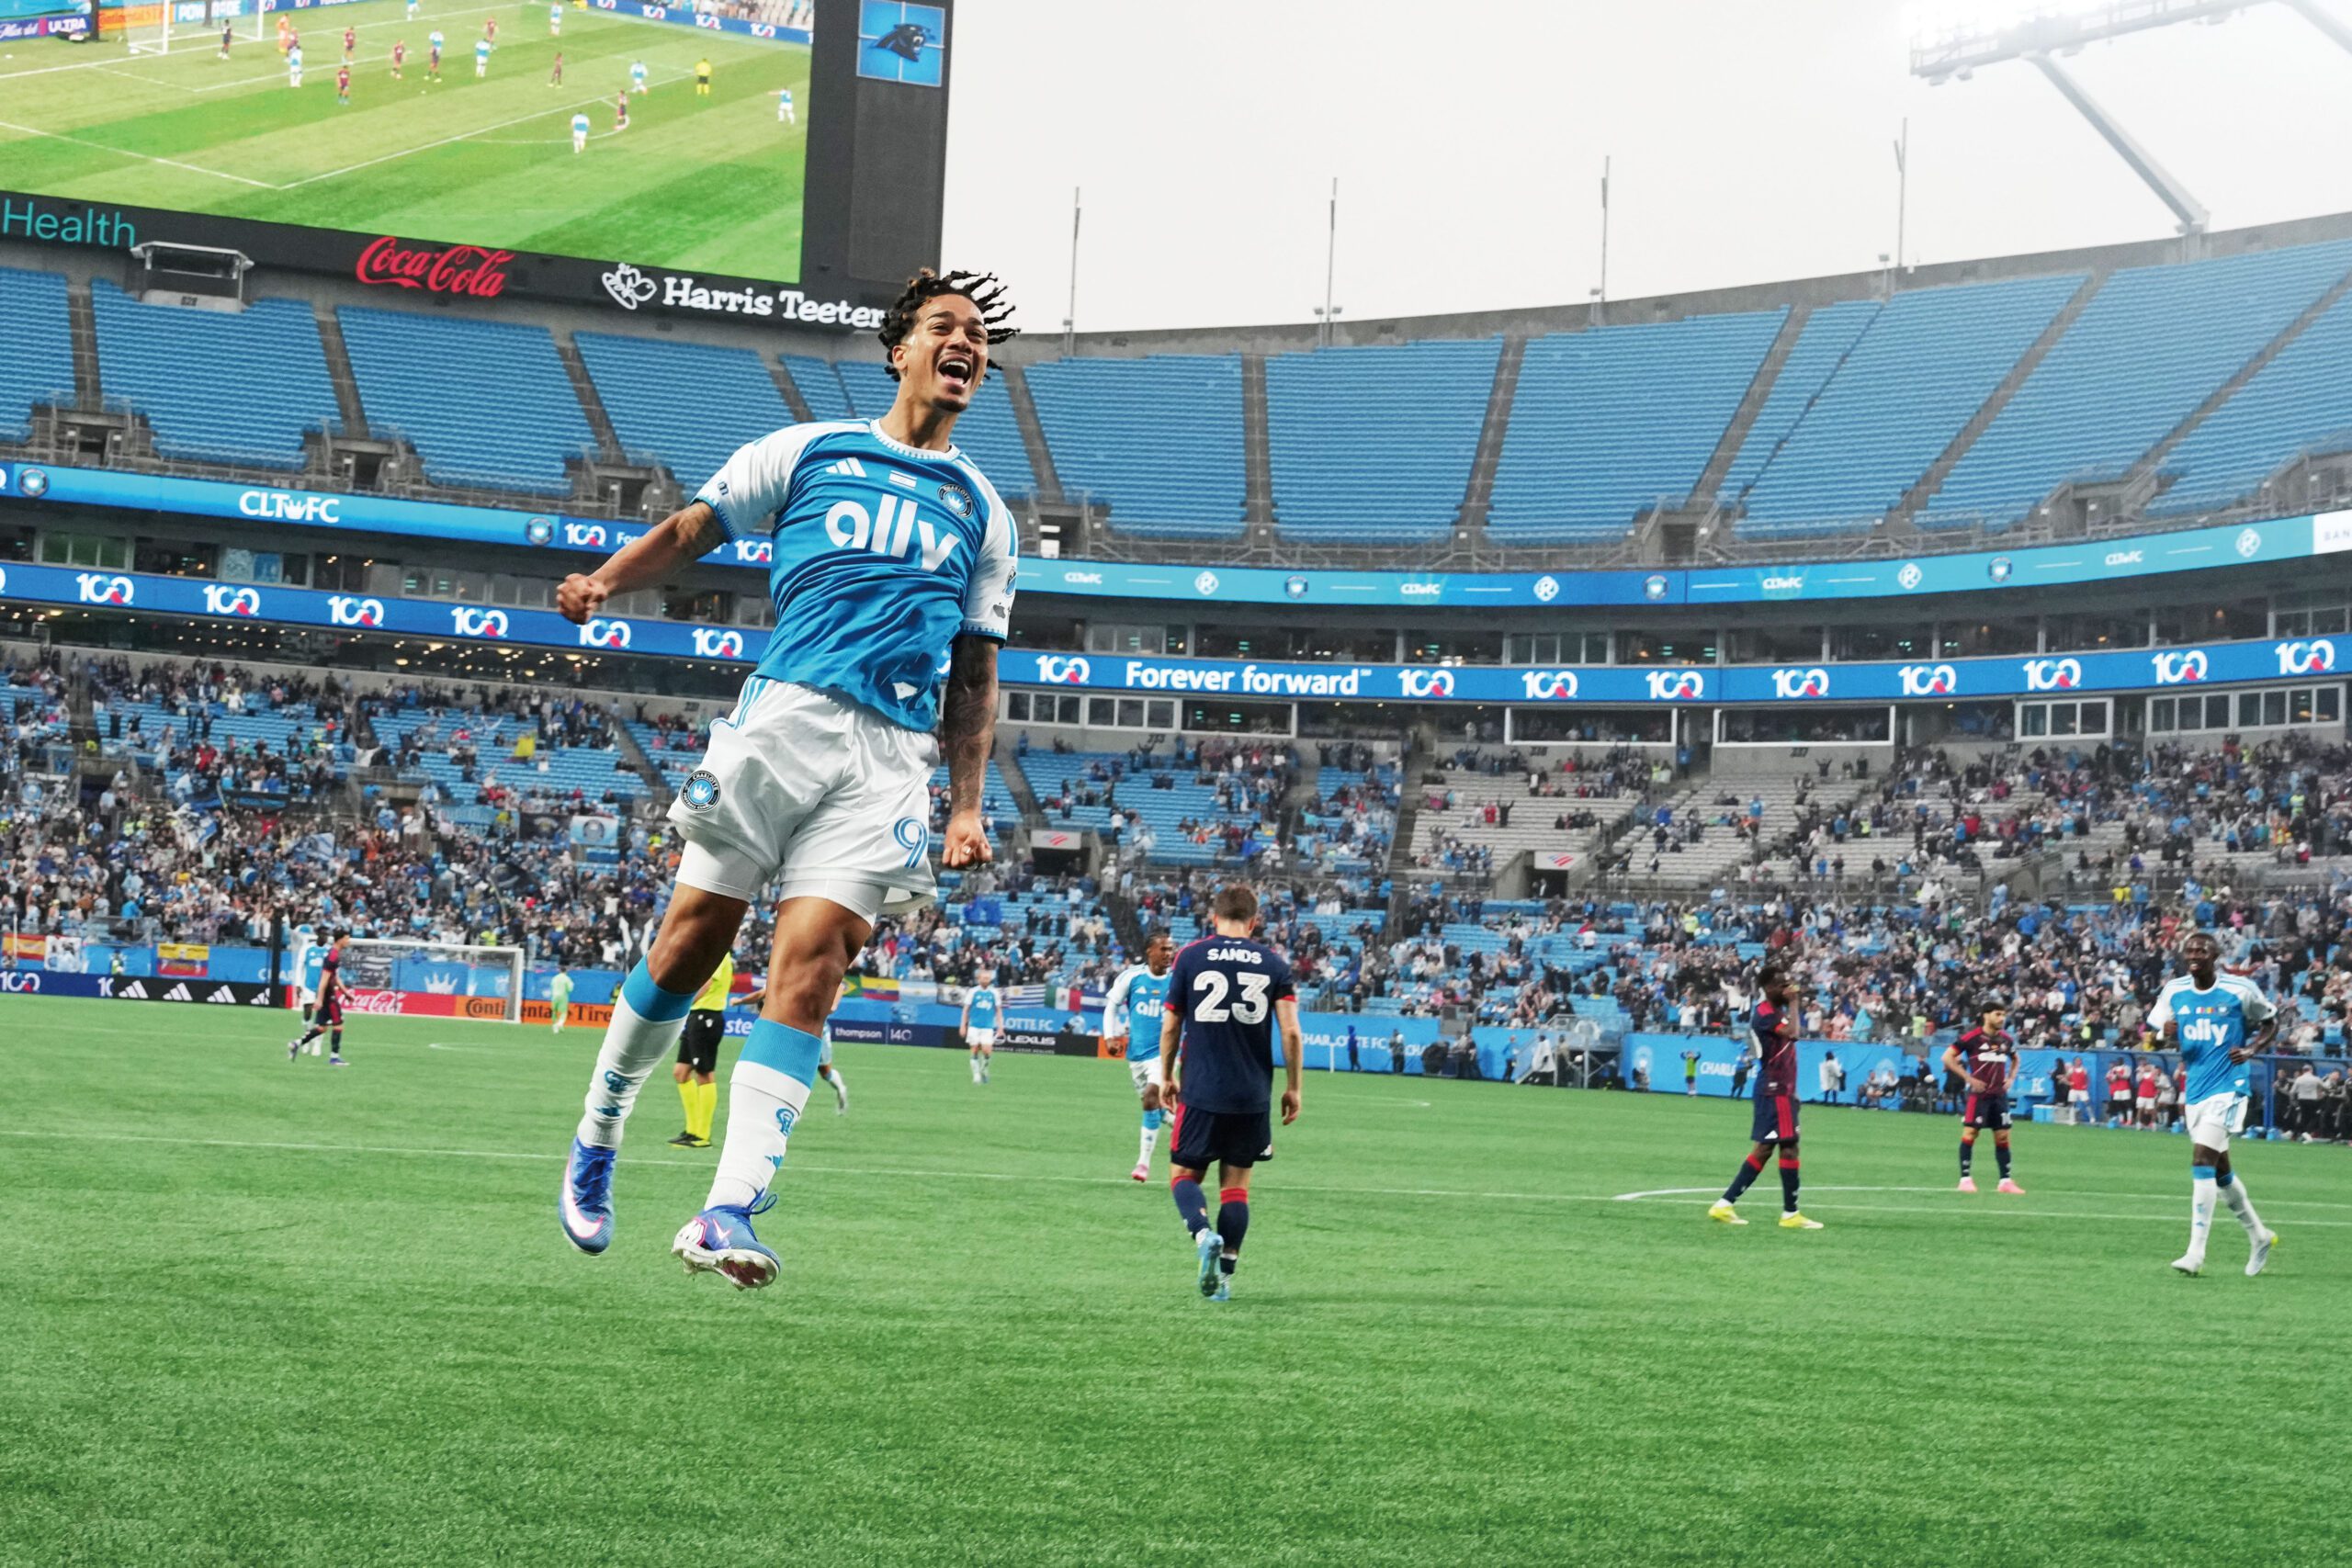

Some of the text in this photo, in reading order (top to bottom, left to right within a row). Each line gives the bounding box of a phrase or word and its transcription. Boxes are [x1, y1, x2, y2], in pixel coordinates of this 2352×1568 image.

[3, 198, 135, 248] Health
[356, 236, 514, 298] Coca-Cola
[663, 277, 886, 328] Harris Teeter
[826, 493, 960, 573] ally
[1035, 655, 1091, 684] 100
[2152, 649, 2209, 684] 100
[2274, 639, 2335, 675] 100
[1126, 661, 1235, 690] Forever
[1397, 669, 1455, 698] 100
[1521, 671, 1578, 699] 100
[1645, 671, 1704, 699] 100
[1771, 669, 1829, 697] 100
[1897, 664, 1957, 695] 100
[2023, 658, 2082, 691] 100
[893, 816, 928, 869] 9
[1207, 948, 1263, 964] SANDS
[466, 998, 612, 1022] Contienta Tire
[1136, 998, 1165, 1018] all
[1193, 970, 1271, 1025] 23
[835, 1026, 883, 1039] thompson
[1007, 1034, 1057, 1045] LEXUS
[2183, 1018, 2229, 1047] ally
